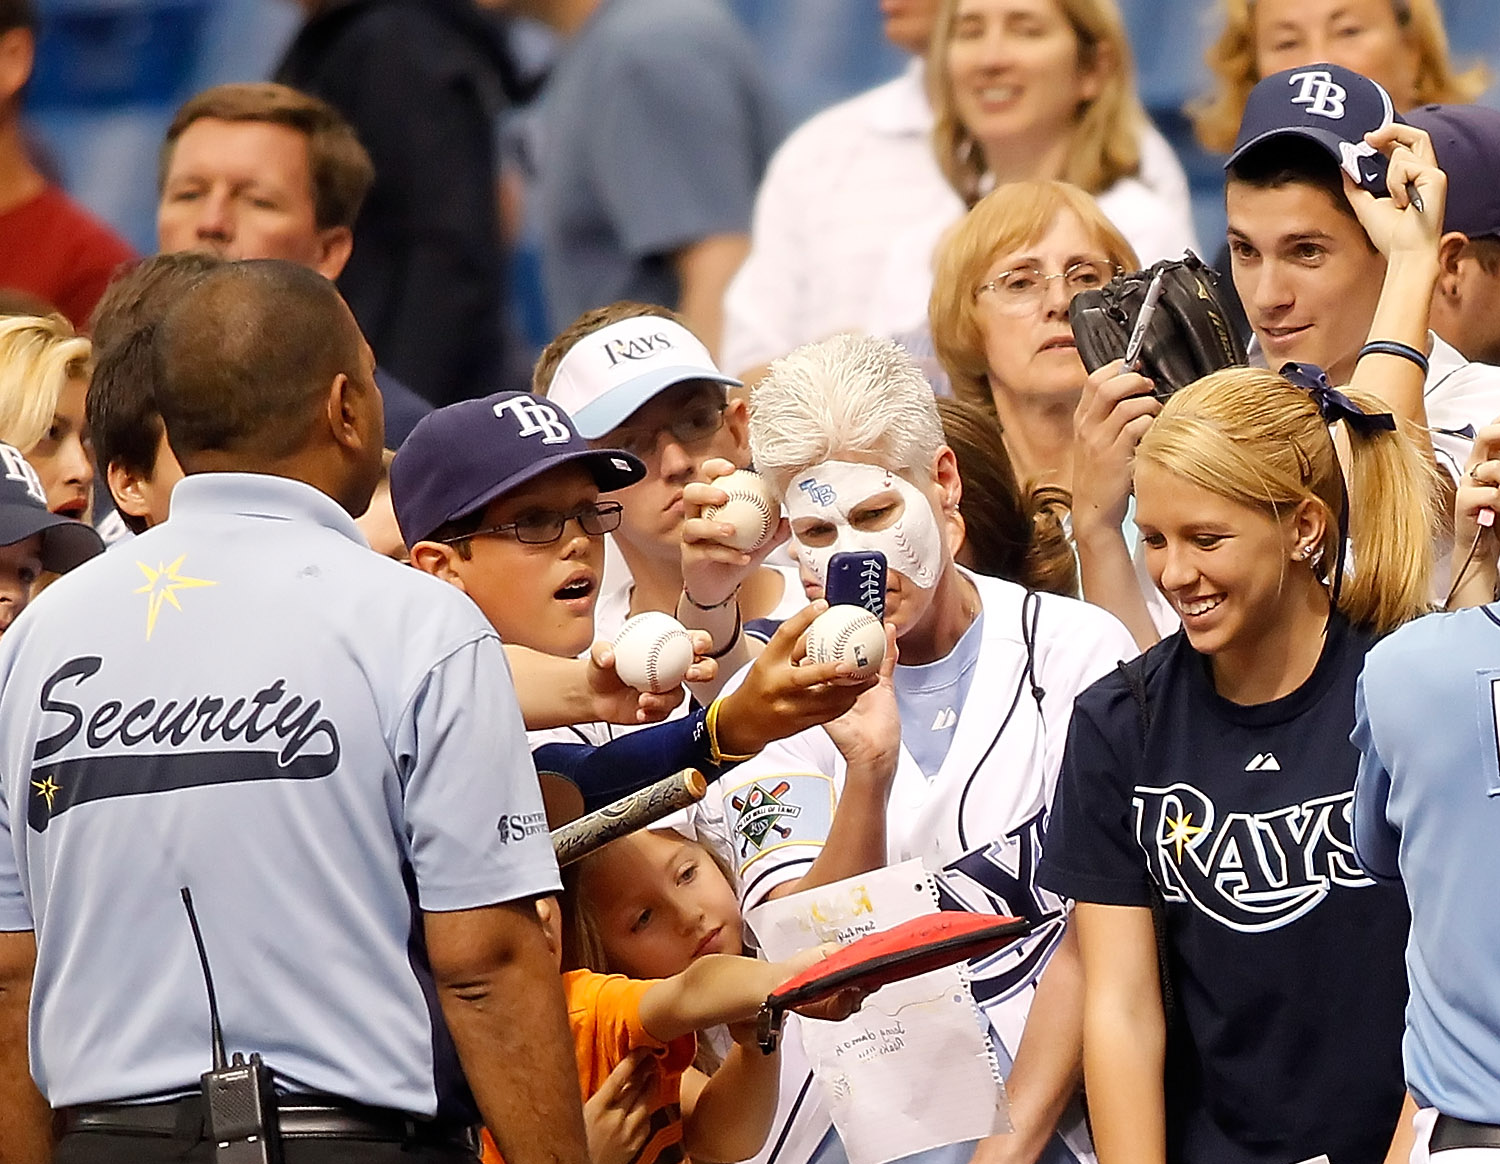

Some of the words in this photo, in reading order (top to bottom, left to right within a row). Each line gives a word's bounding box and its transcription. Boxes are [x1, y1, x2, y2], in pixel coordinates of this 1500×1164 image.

[1288, 71, 1348, 119] TB
[493, 395, 572, 446] TB
[33, 655, 341, 768] Security
